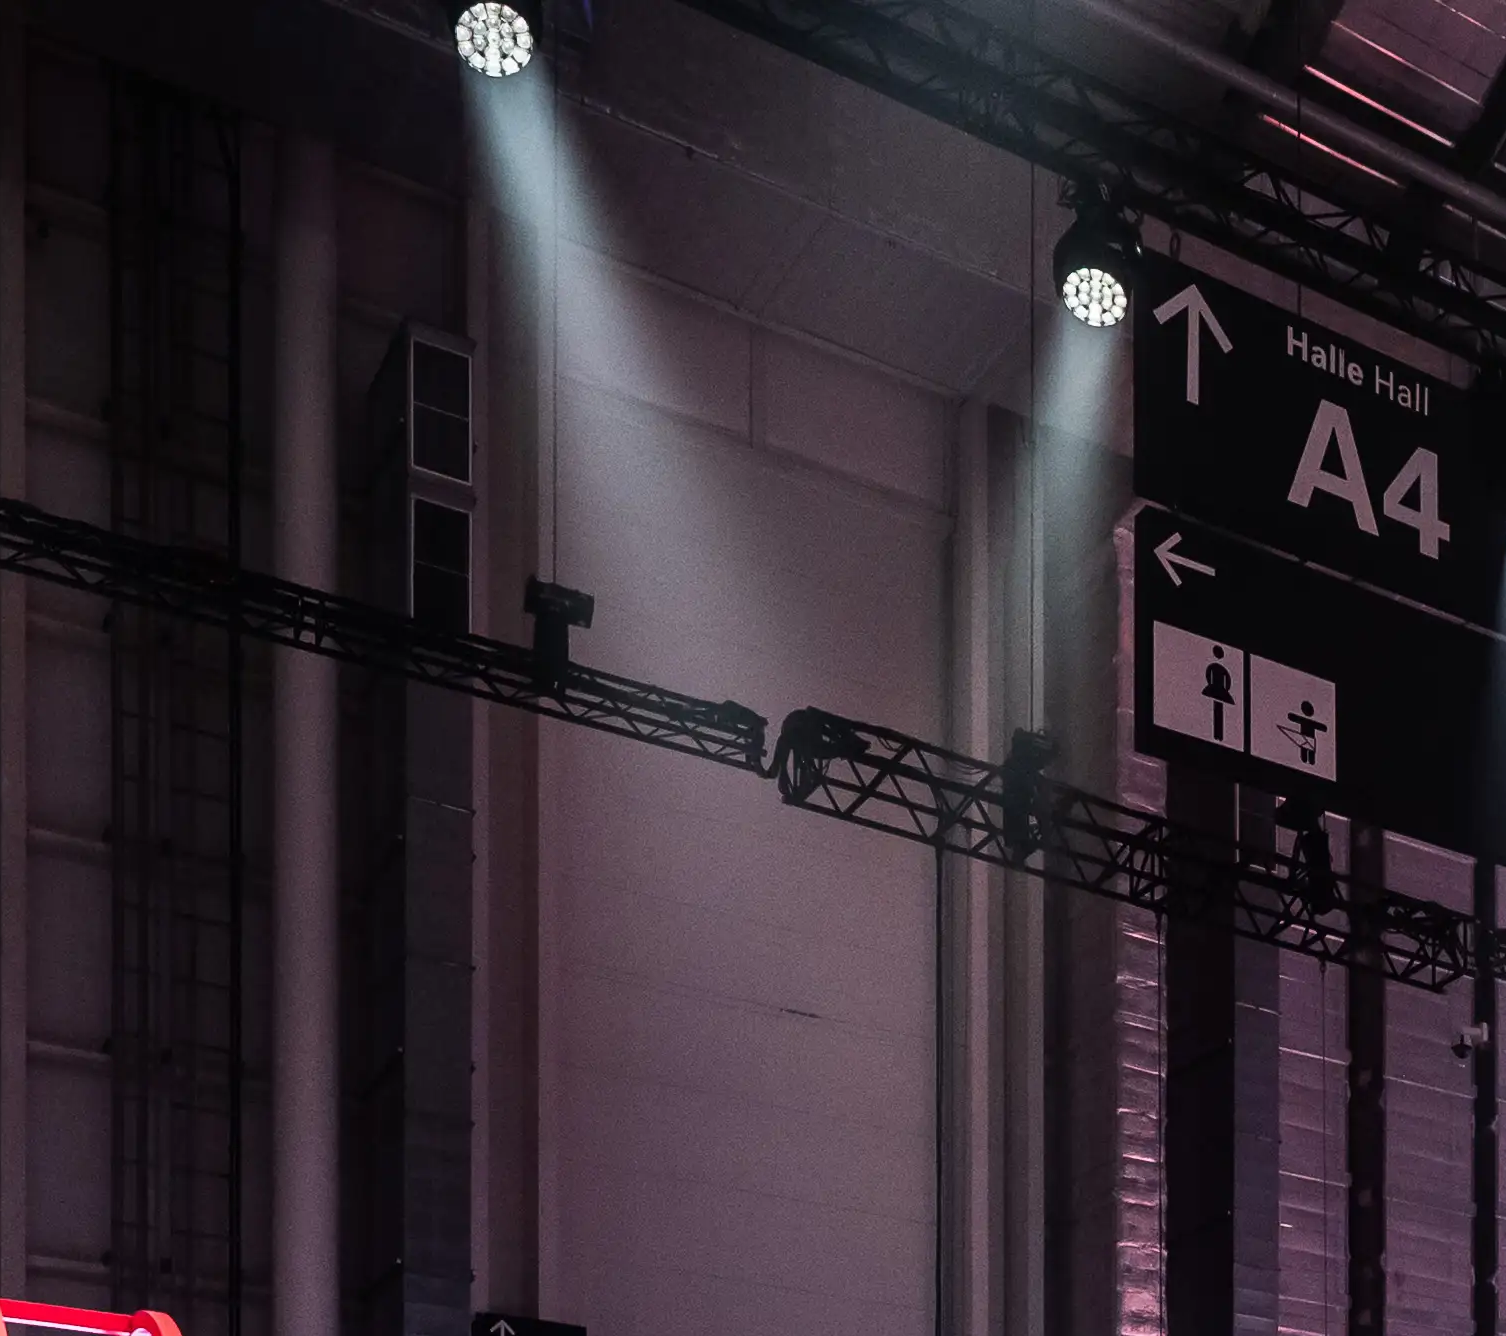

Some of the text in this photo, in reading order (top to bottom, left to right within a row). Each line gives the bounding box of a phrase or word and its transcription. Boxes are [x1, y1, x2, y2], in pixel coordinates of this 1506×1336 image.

[1286, 325, 1430, 416] Halle Hall
[1286, 398, 1451, 560] A4
